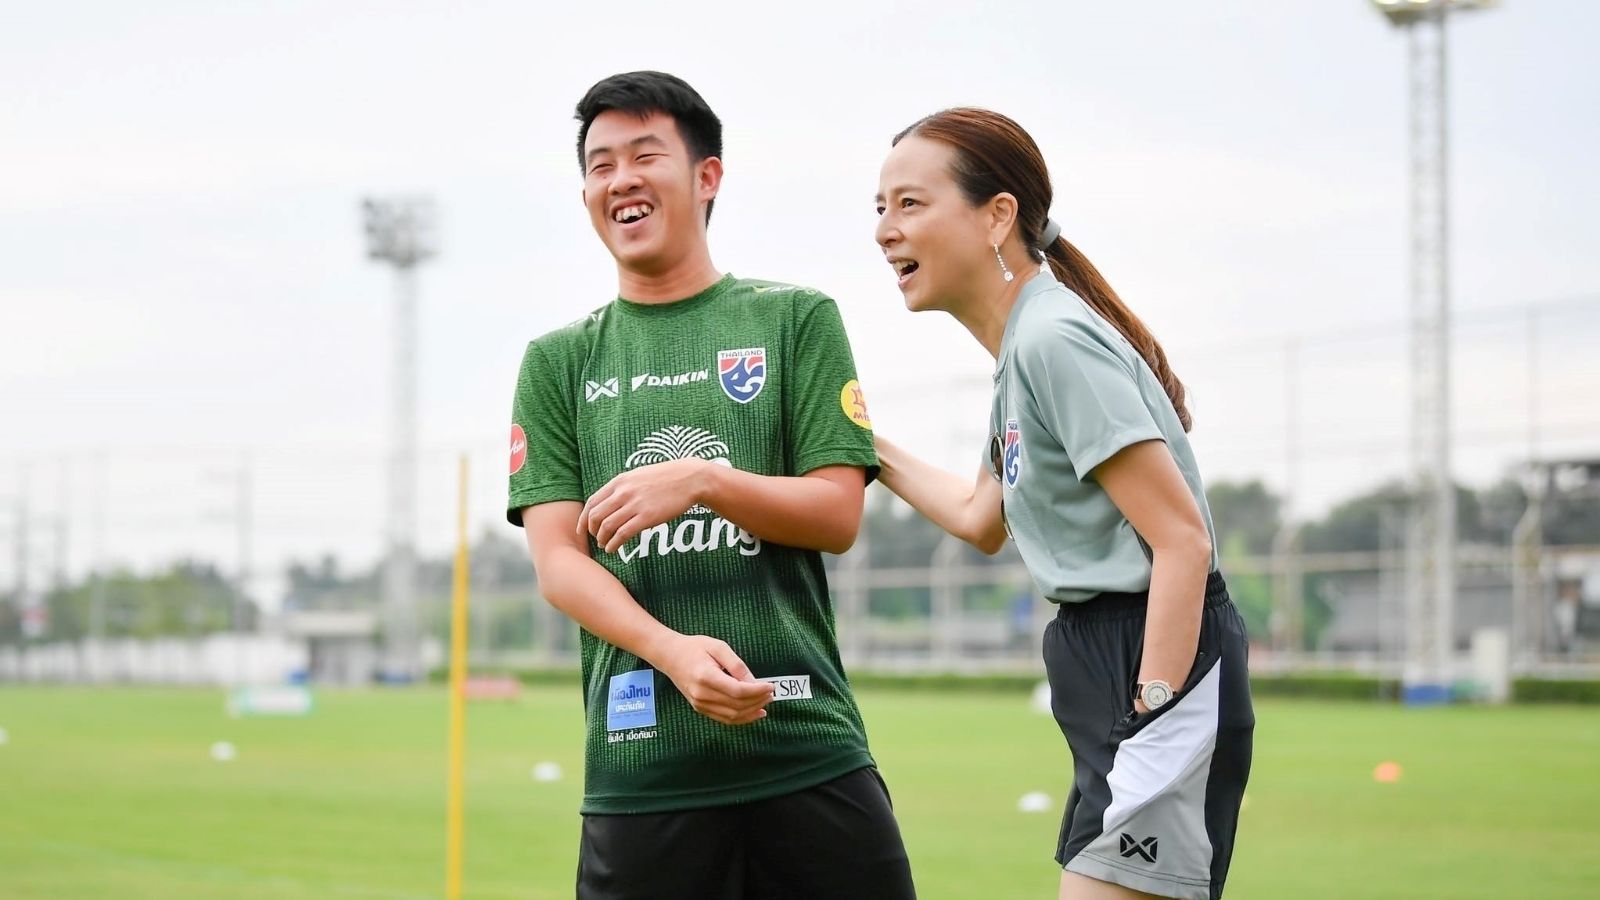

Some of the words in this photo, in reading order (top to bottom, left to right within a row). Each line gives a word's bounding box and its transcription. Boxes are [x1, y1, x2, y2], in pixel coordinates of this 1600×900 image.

[720, 350, 762, 359] THAILAND
[647, 369, 709, 387] DAIKIN
[768, 679, 807, 698] TSBY
